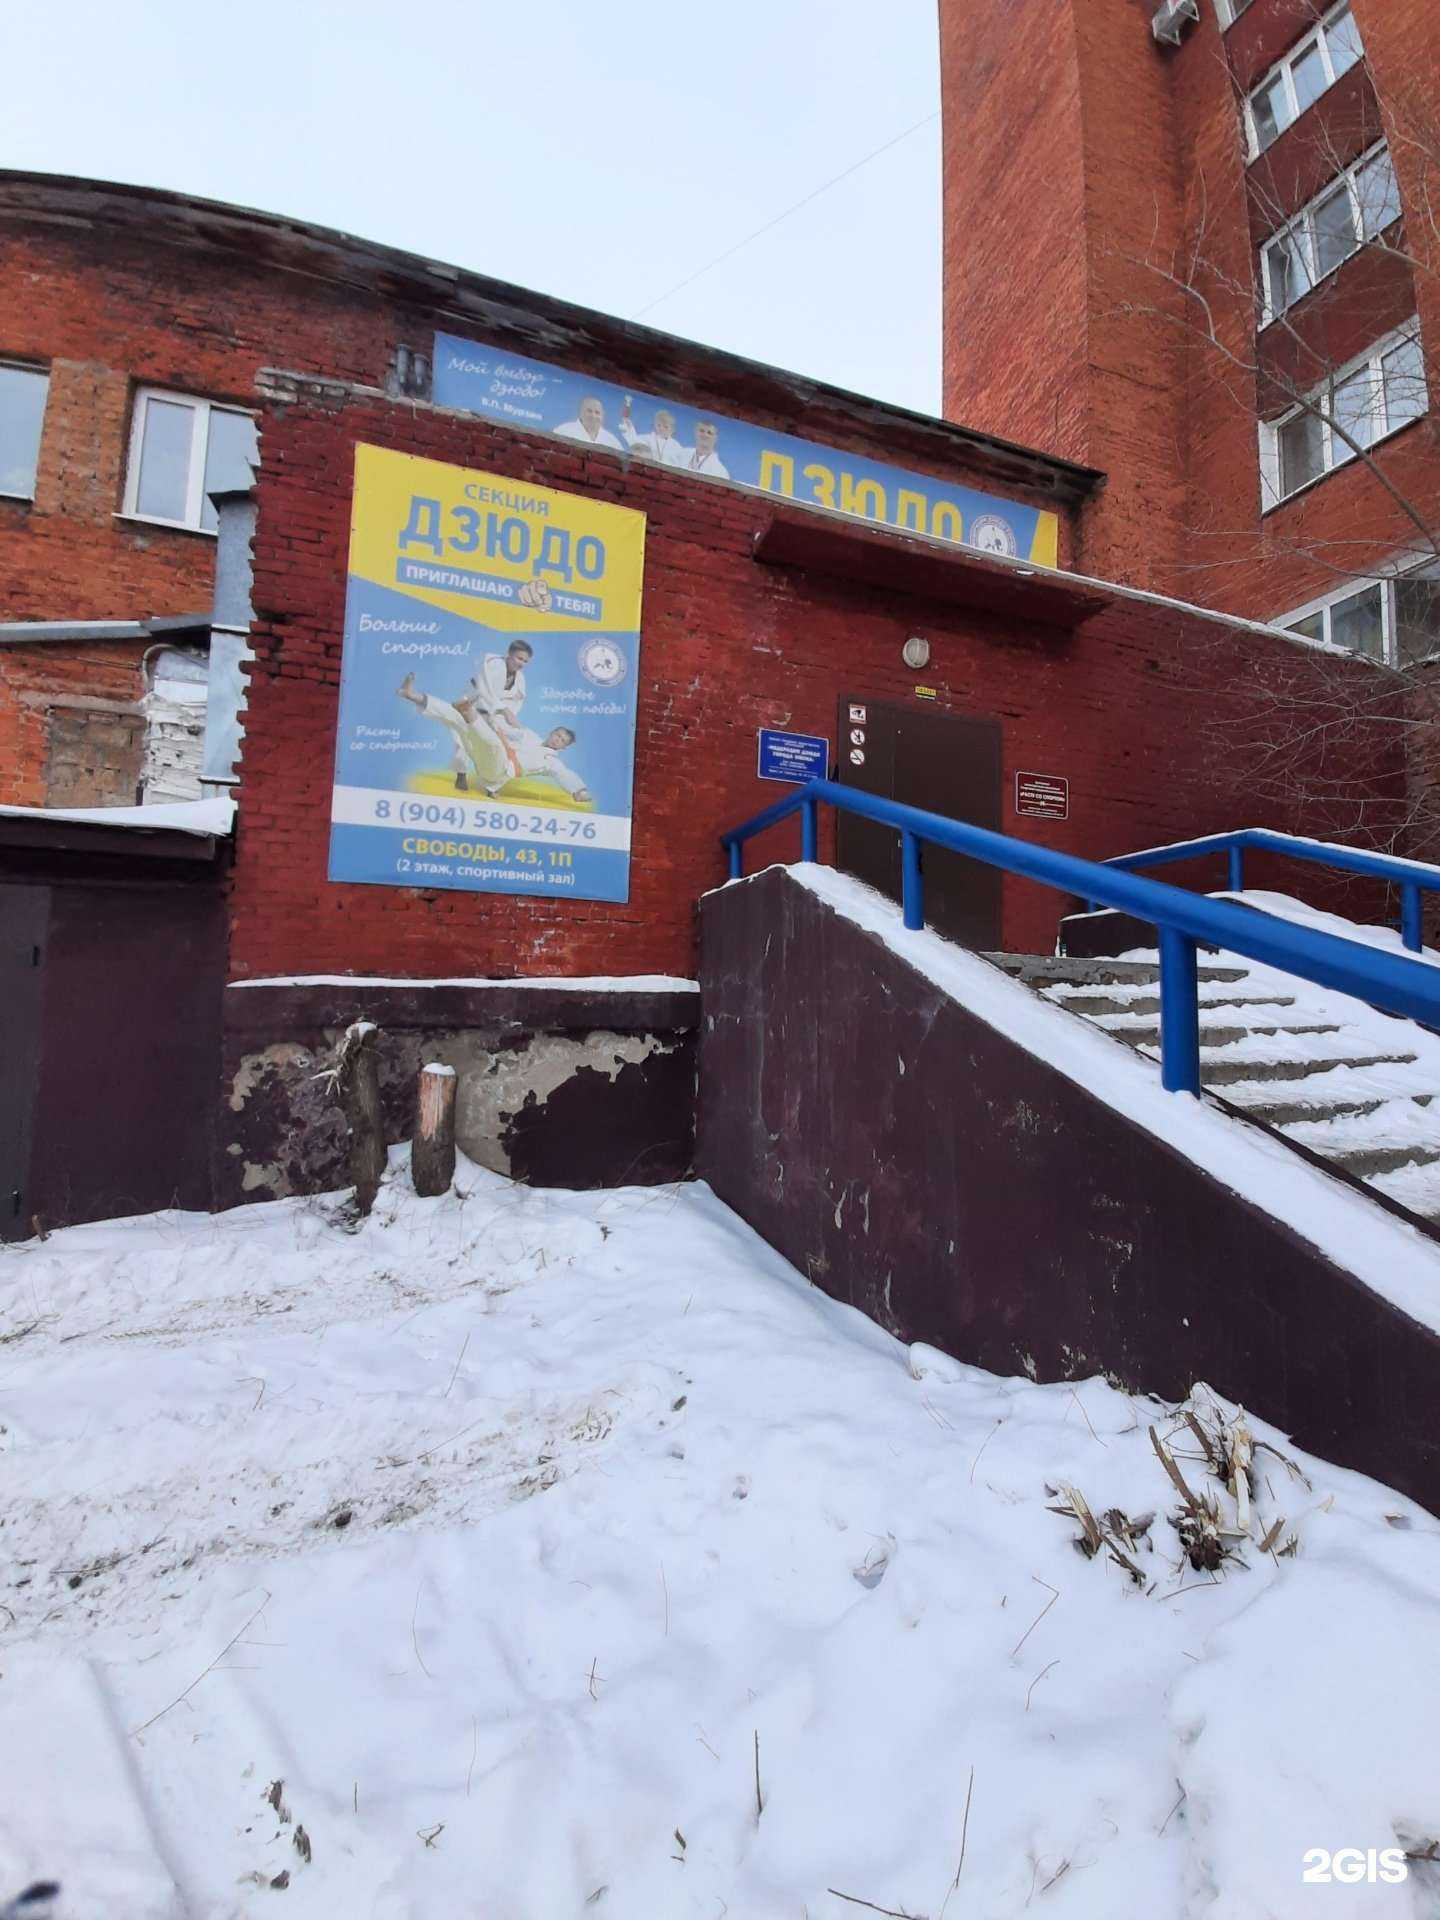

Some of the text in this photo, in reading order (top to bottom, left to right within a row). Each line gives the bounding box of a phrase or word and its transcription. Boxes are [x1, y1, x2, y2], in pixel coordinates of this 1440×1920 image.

[448, 357, 489, 375] Мой
[464, 483, 550, 516] СЕКЦИЯ
[397, 494, 606, 584] ДЗЮДО
[405, 564, 597, 617] ПРИГЛАШАЮ ТЕБЯ!
[359, 612, 442, 635] Больше
[381, 640, 472, 660] спорта!
[374, 799, 598, 840] 8 (904) 580-24-76
[402, 836, 574, 868] СВОБОДЫ, 43, 1П
[396, 857, 577, 887] (2 этаж, спортивный зал)
